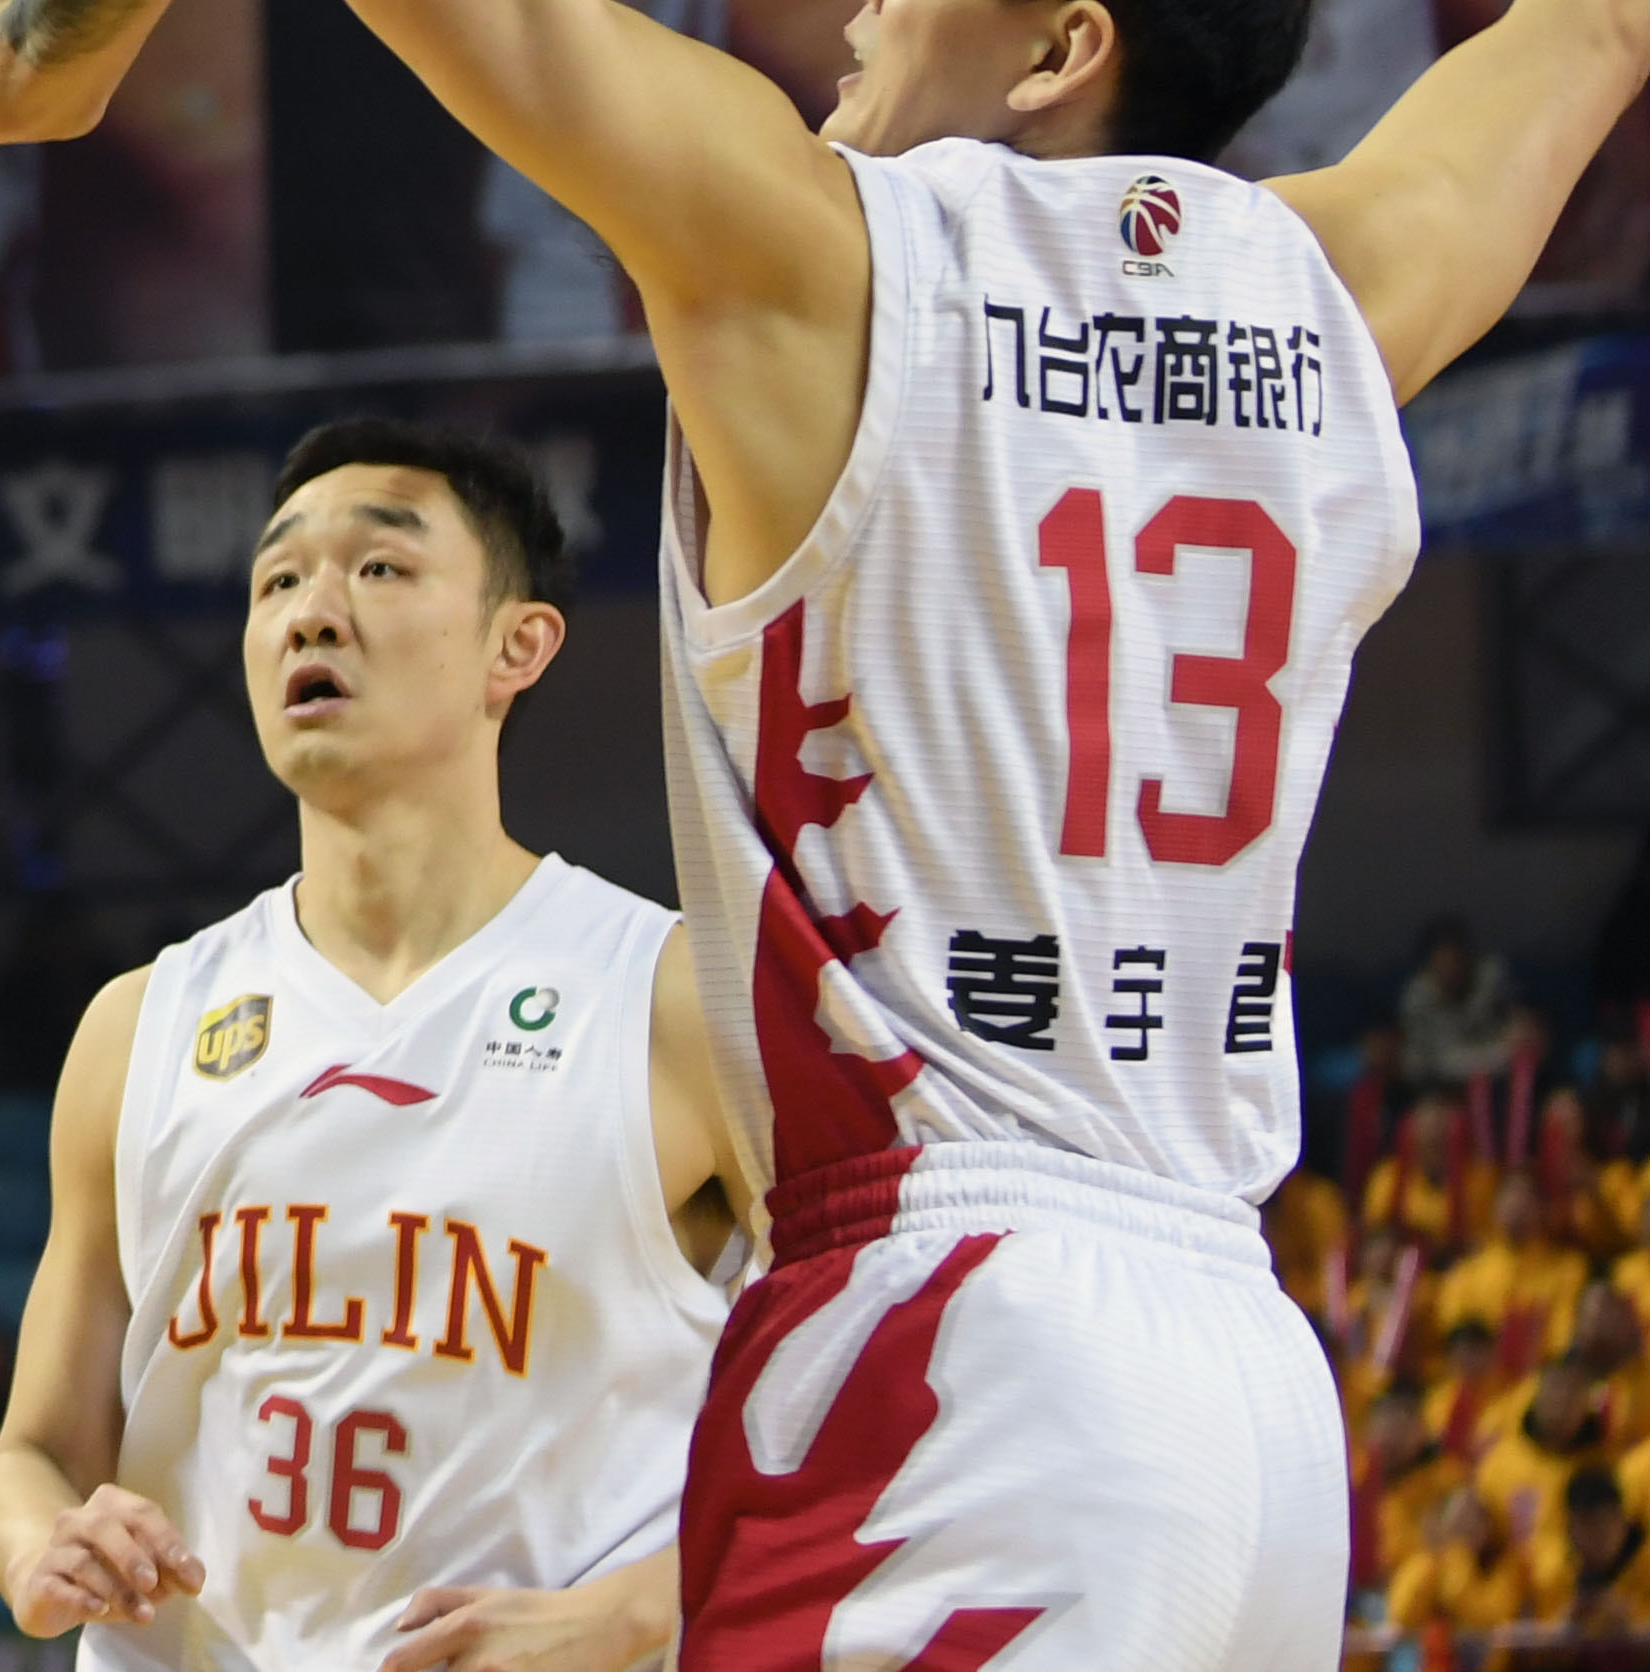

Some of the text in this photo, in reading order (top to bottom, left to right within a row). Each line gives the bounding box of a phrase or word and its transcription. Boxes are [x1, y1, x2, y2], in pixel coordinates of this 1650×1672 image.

[1123, 260, 1175, 277] CBA
[1037, 486, 1298, 868] 13
[198, 1014, 264, 1071] ups
[168, 1204, 549, 1378] JILIN
[247, 1393, 410, 1552] 36
